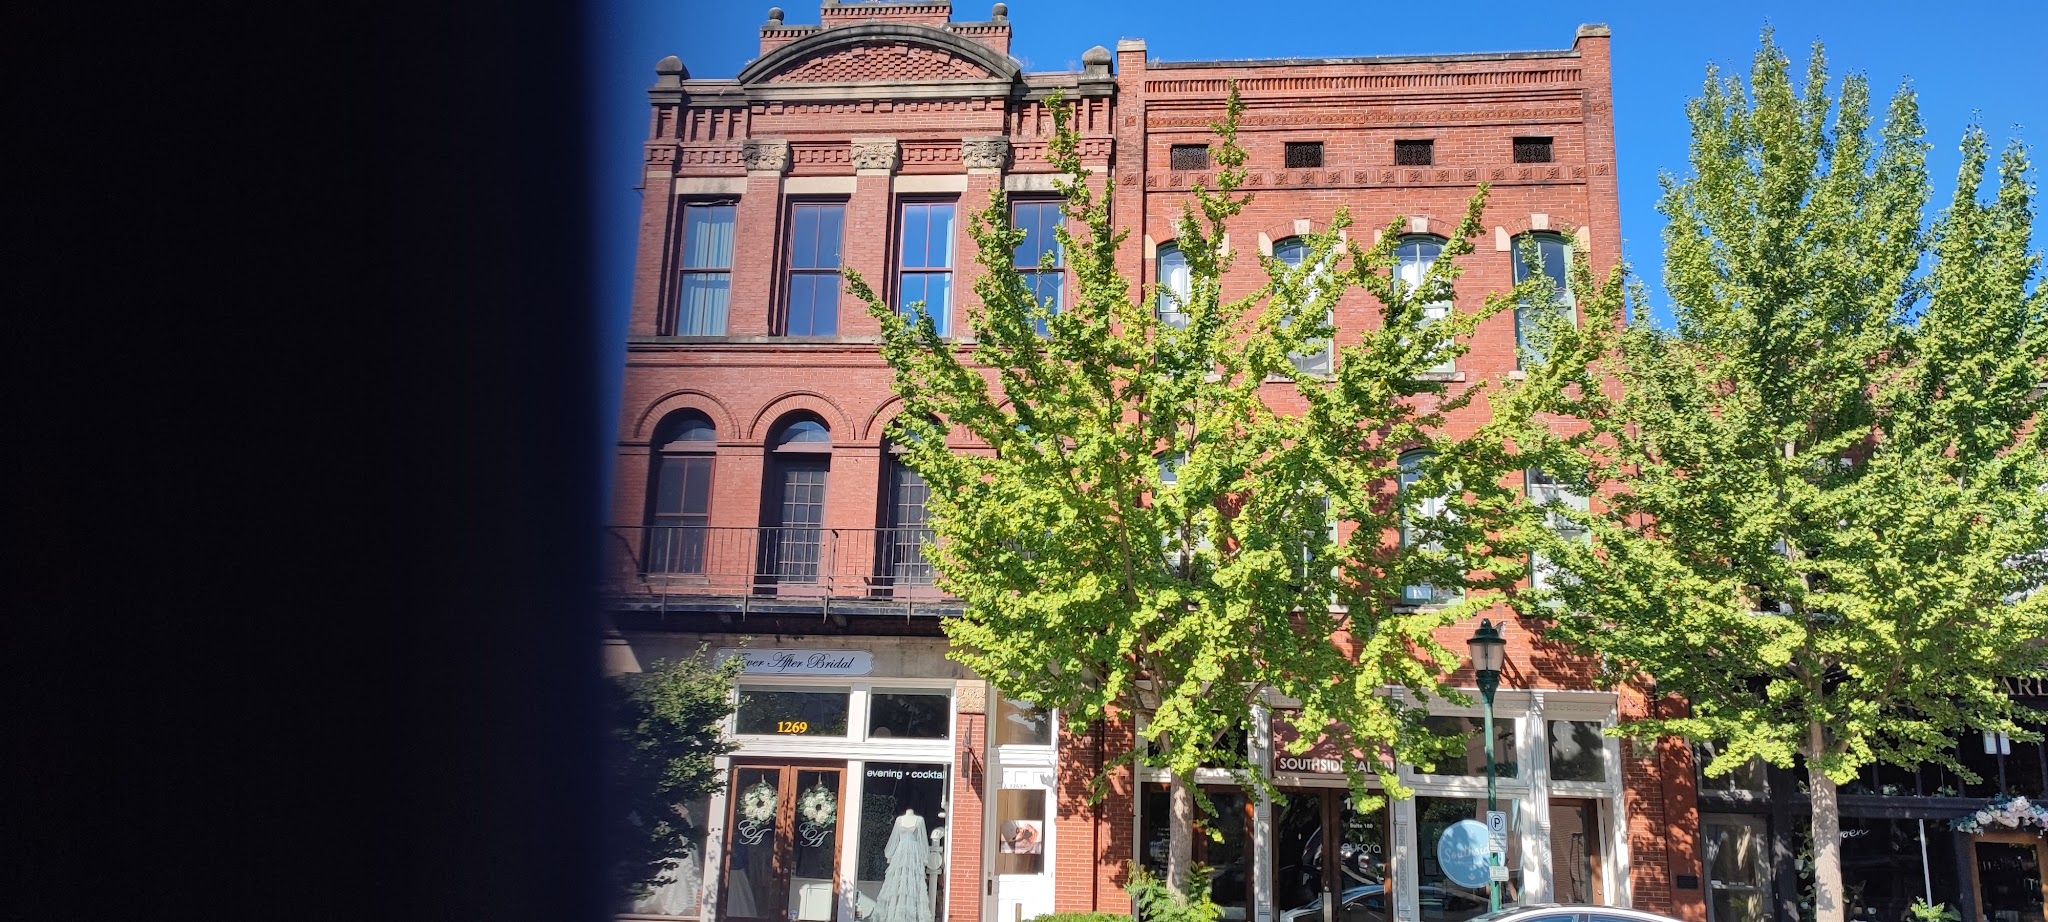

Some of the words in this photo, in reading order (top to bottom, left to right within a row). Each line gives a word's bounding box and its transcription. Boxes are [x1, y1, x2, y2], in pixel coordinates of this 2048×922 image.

[767, 651, 803, 672] After
[806, 652, 856, 669] Bridal
[777, 721, 808, 734] 1269
[866, 769, 903, 780] evening
